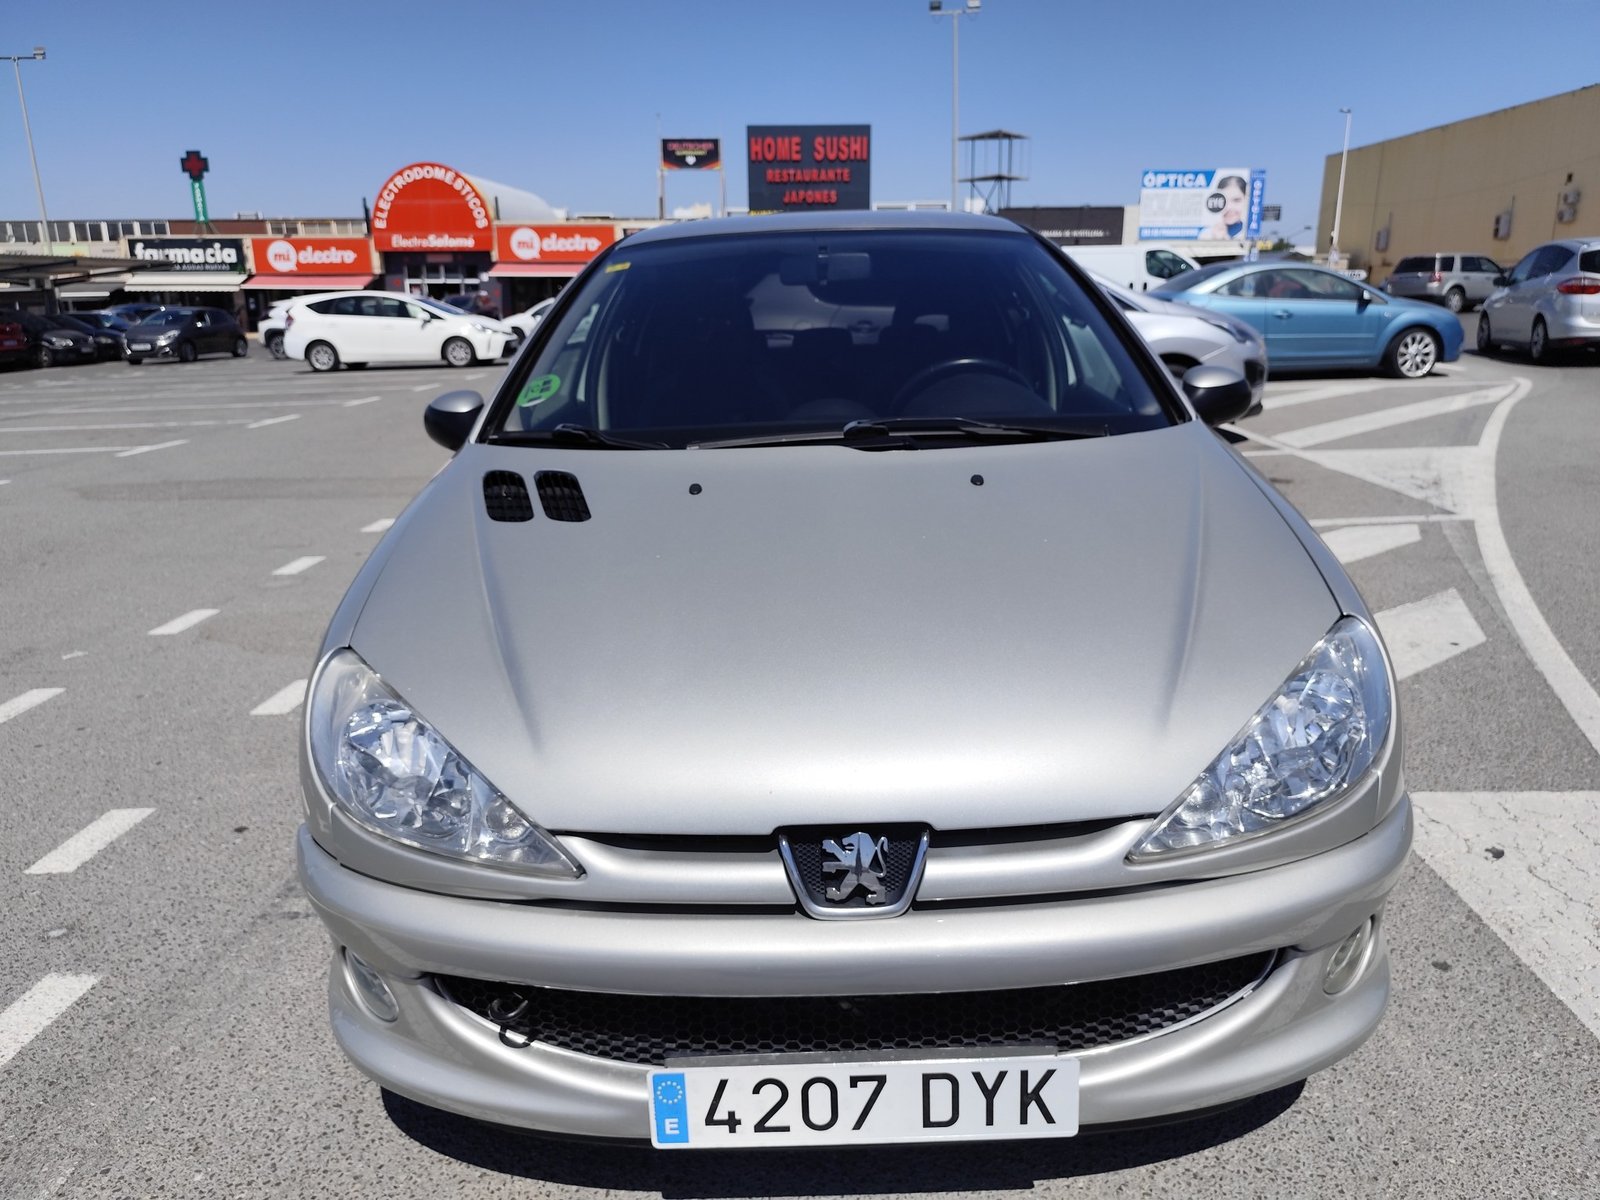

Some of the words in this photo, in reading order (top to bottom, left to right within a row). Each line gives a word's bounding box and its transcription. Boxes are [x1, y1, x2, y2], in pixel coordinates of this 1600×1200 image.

[750, 136, 802, 161] HOME
[813, 136, 868, 161] SUSHI
[766, 168, 850, 182] RESTAURANTE
[1143, 171, 1208, 188] ÓPTICA
[783, 190, 838, 204] JAPONES
[517, 238, 534, 250] mi
[541, 232, 600, 252] electro
[134, 242, 238, 263] farmacia
[274, 249, 291, 262] mi
[298, 245, 356, 264] electro
[704, 1073, 888, 1134] 4207
[921, 1068, 1059, 1129] DYK
[664, 1118, 680, 1135] E
